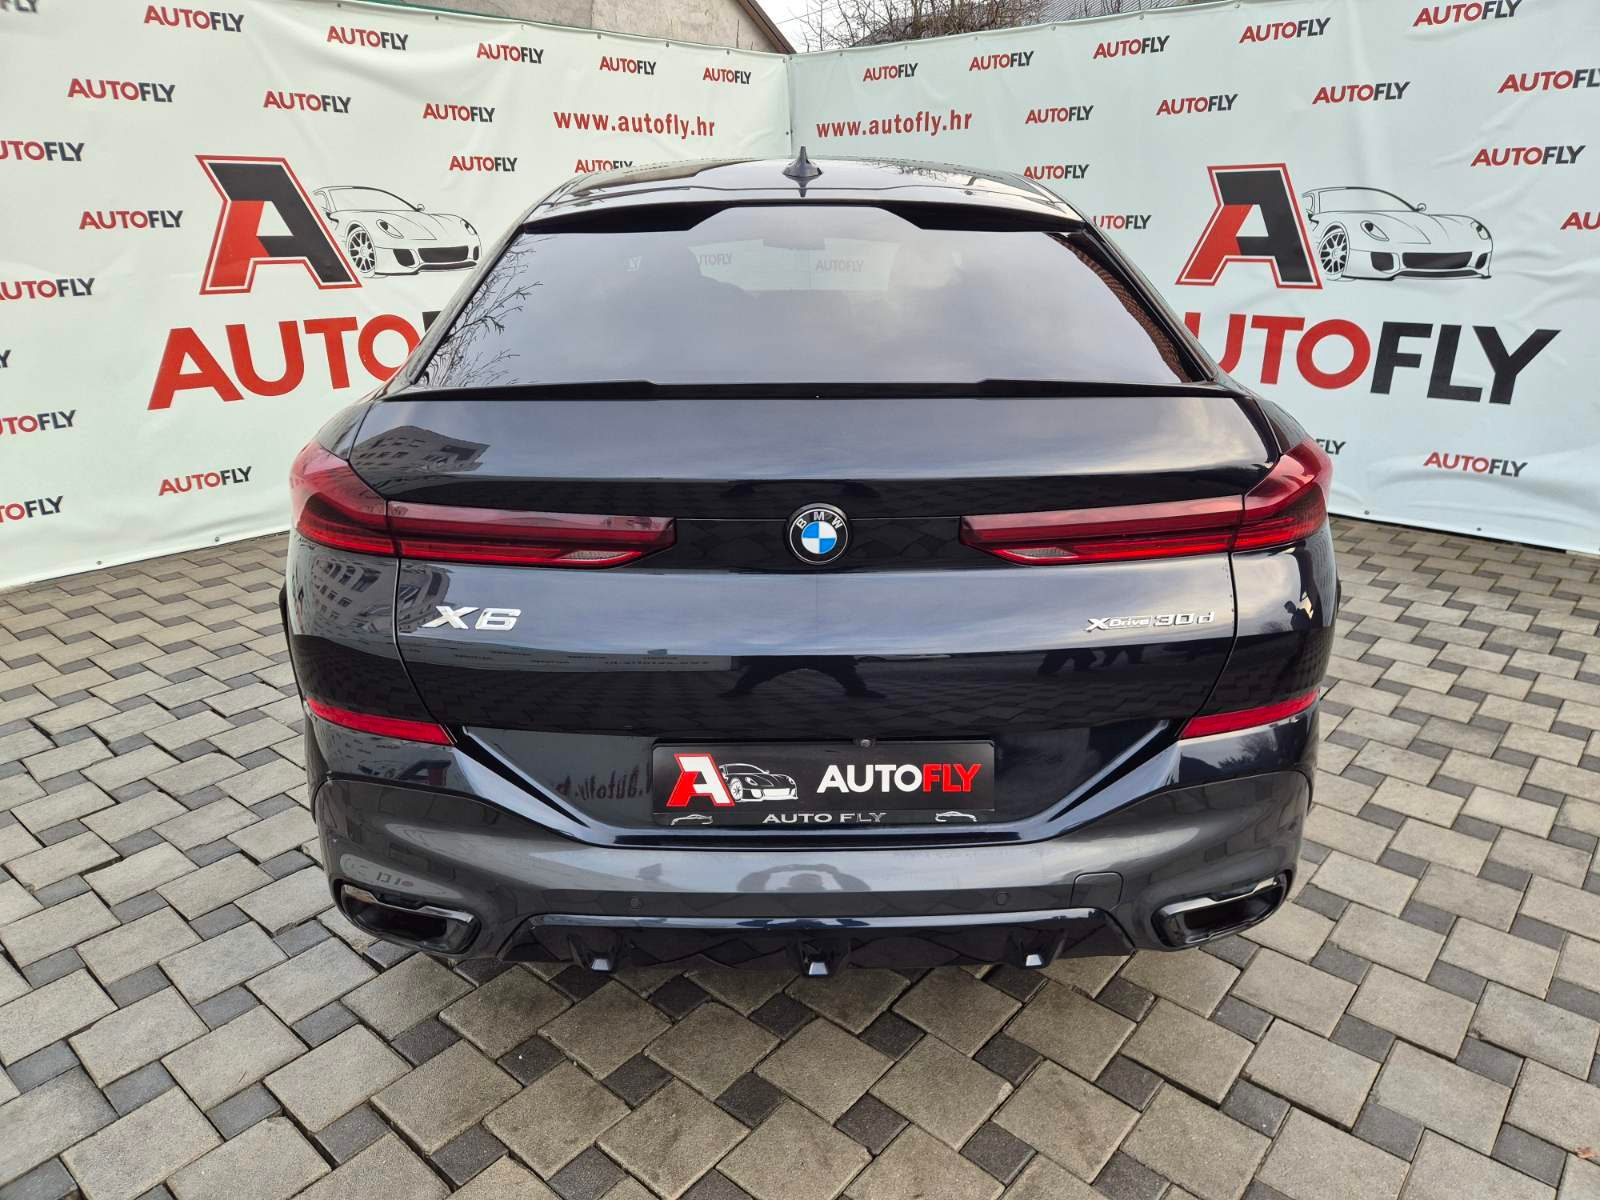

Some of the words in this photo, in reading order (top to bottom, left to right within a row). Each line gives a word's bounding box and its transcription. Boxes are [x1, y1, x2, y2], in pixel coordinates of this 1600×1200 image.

[144, 5, 244, 32] AUTOFLY
[1413, 0, 1522, 27] AUTOFLY
[327, 26, 408, 50] AUTOFLY
[1239, 17, 1331, 43] AUTOFLY
[477, 43, 544, 64] AUTOFLY
[1093, 35, 1170, 59] AUTOFLY
[600, 56, 657, 75] AUTOFLY
[863, 63, 919, 82] AUTOFLY
[969, 51, 1034, 71] AUTOFLY
[703, 67, 752, 85] AUTOFLY
[1497, 68, 1600, 93] AUTOFL
[67, 78, 175, 103] AUTOFLY
[263, 91, 351, 113] AUTOFLY
[1312, 82, 1410, 105] AUTOFLY
[423, 103, 495, 123] AUTOFLY
[1025, 105, 1094, 124] AUTOFLY
[1156, 94, 1238, 115] AUTOFLY
[553, 111, 715, 139] www.autofly.hr
[816, 109, 972, 138] www.autofly.hr
[449, 156, 518, 172] AUTOFLY
[1470, 145, 1586, 167] AUTOFLY
[1023, 164, 1089, 180] AUTOFLY
[79, 210, 183, 230] AUTOFLY
[1092, 214, 1152, 230] UTOFLY
[0, 277, 95, 300] UTOFLY
[147, 310, 443, 410] AUTO
[1184, 311, 1561, 405] UTOFLY
[0, 409, 76, 436] TOFLY
[1424, 451, 1528, 478] AUTOFLY
[159, 465, 252, 497] AUTOFLY
[421, 606, 521, 630] X6
[816, 764, 983, 793] AUTOFLY
[762, 813, 833, 824] AUTO
[839, 812, 887, 824] FLY
